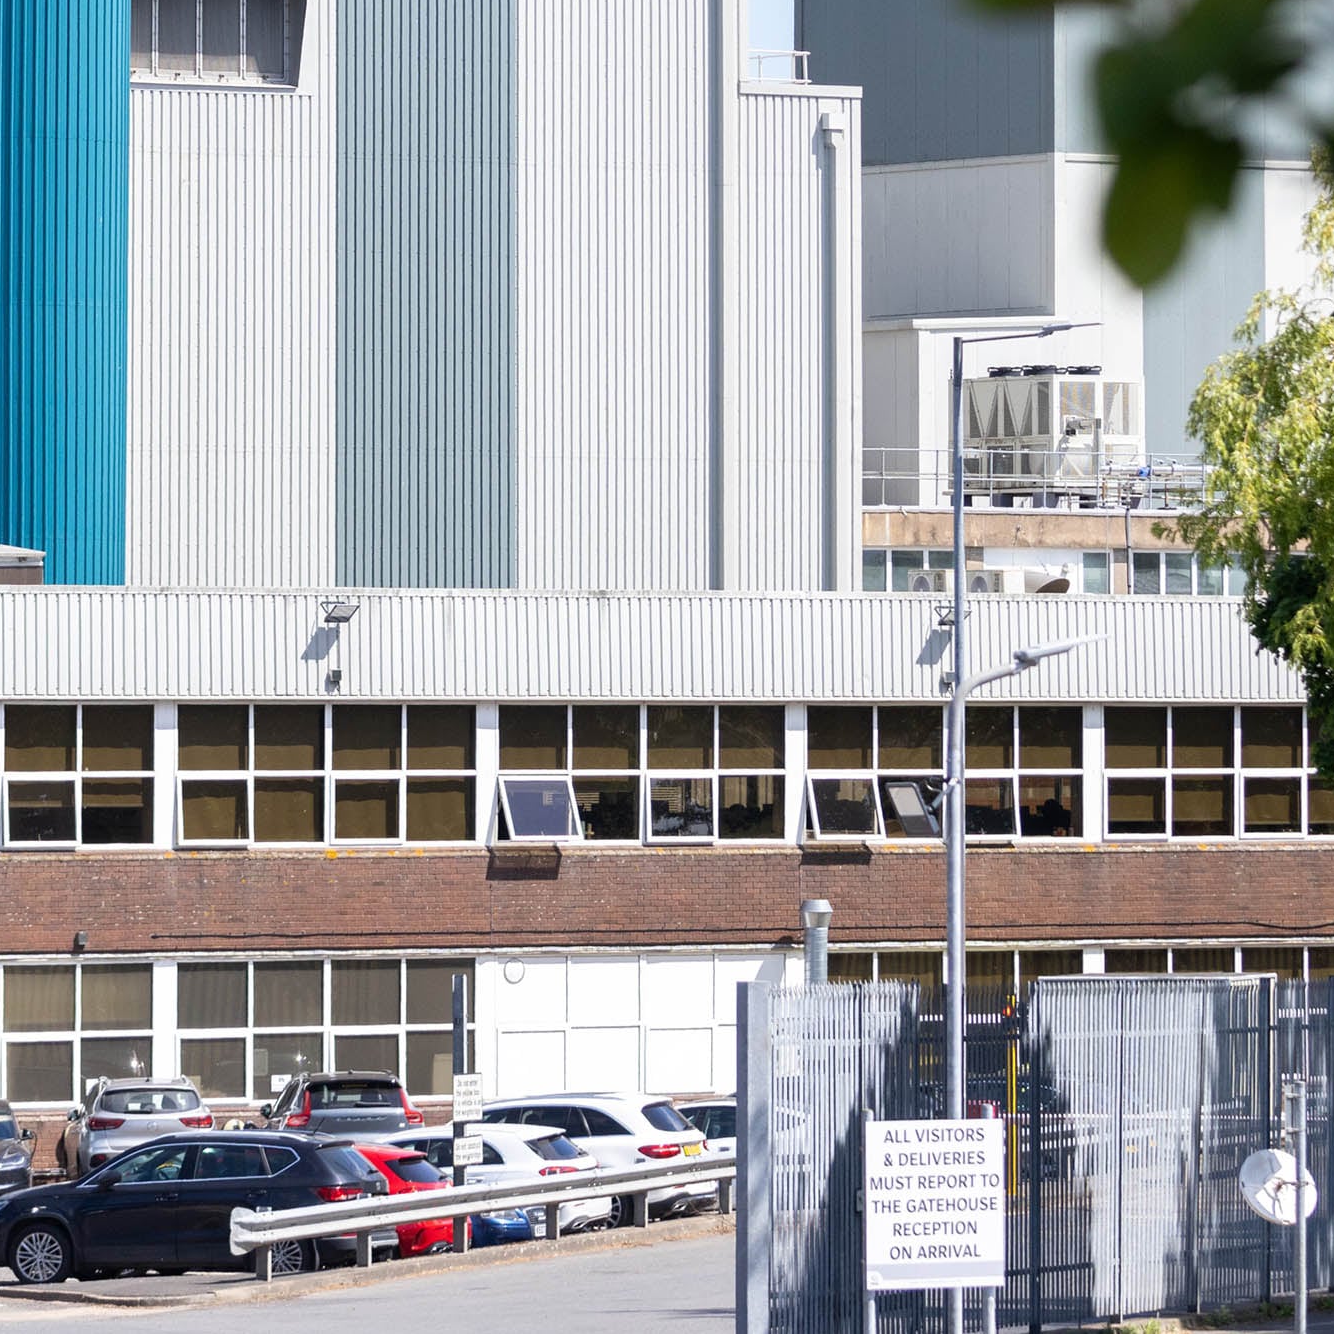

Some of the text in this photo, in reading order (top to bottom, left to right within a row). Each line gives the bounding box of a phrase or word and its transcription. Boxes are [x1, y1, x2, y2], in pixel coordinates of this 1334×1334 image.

[883, 1127, 985, 1144] ALL VISITORS
[883, 1151, 986, 1167] & DELIVERIES
[870, 1173, 1000, 1191] MUST REPORT TO
[871, 1197, 998, 1214] THE GATEHOUSE
[892, 1221, 978, 1237] RECEPTION
[889, 1243, 981, 1260] ON ARRIVAL
